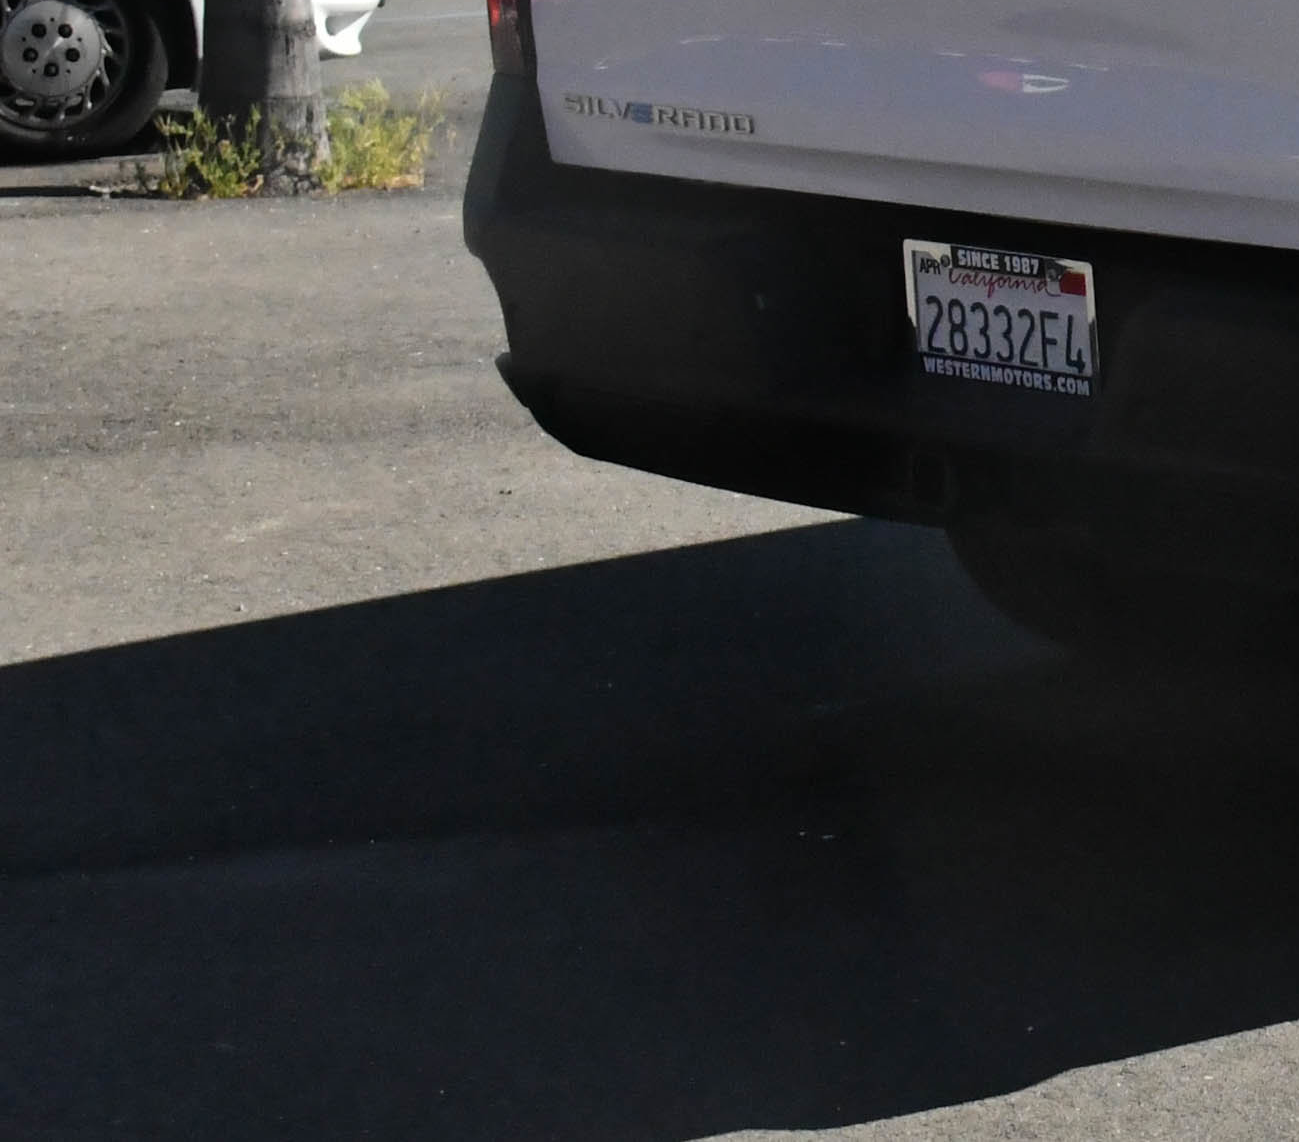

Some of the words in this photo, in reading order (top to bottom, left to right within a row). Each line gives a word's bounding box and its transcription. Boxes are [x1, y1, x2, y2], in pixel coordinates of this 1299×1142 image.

[956, 249, 1000, 270] SINCE
[1003, 255, 1040, 275] 1987
[925, 294, 1087, 375] 28332F4
[923, 355, 1090, 396] WESTERNMOTORS.COM
